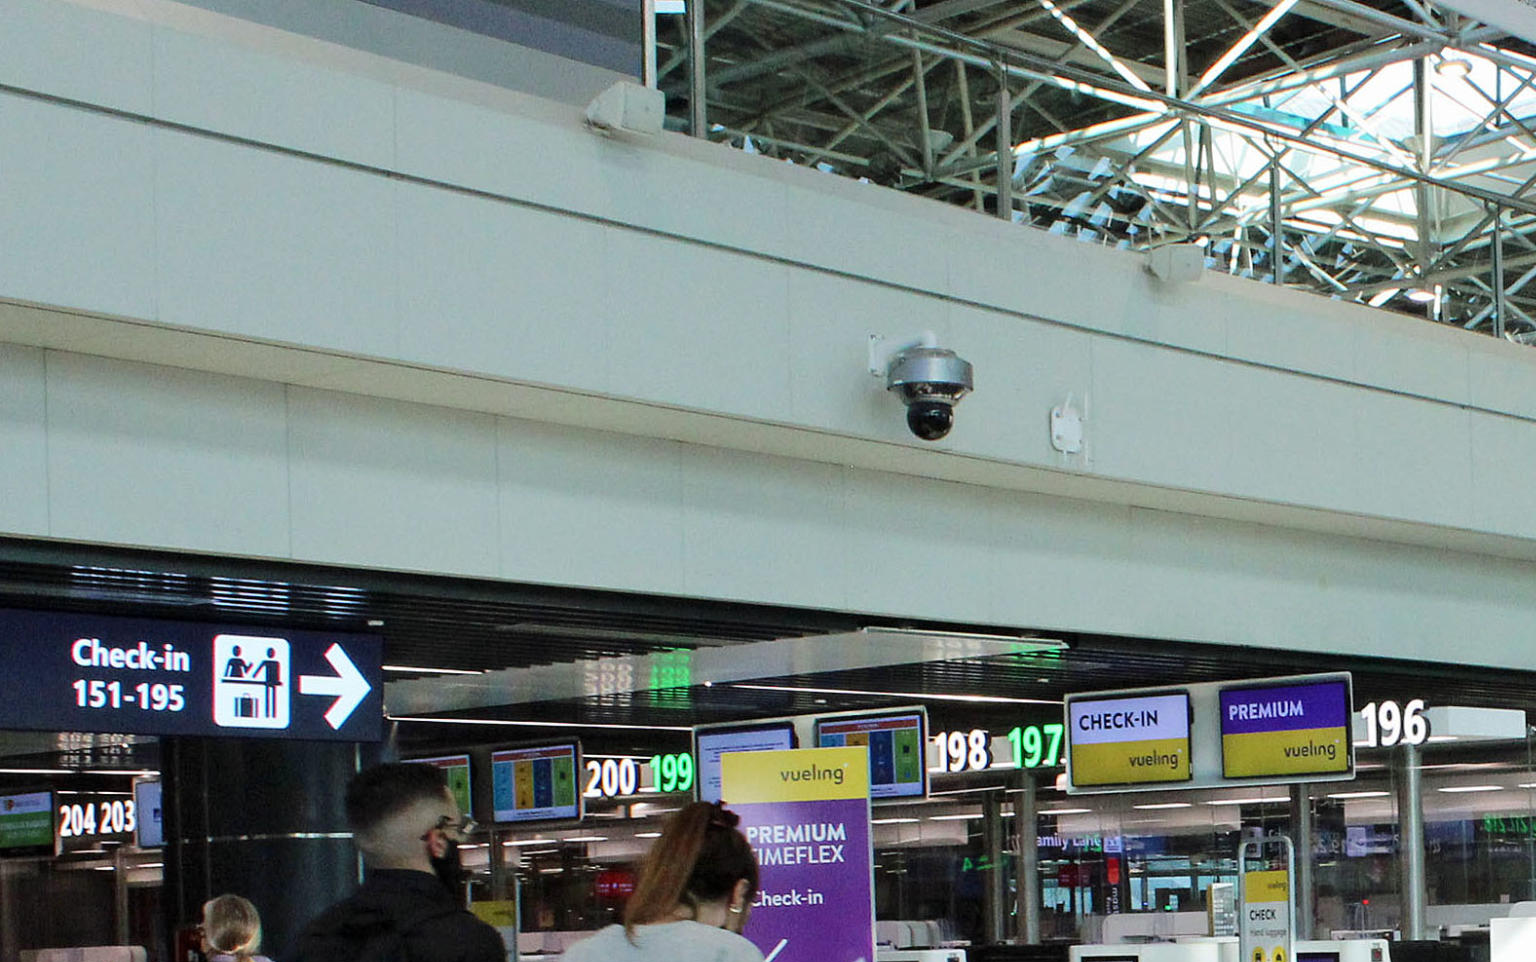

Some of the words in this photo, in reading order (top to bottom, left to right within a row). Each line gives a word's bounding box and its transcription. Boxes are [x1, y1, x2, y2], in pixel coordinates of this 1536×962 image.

[71, 638, 191, 672] Check-in
[72, 679, 185, 712] 151-195
[1229, 700, 1304, 720] PREMIUM
[1079, 710, 1158, 731] CHECK-IN
[1361, 699, 1429, 747] 196
[934, 729, 990, 772] 198
[1007, 723, 1064, 768] 197
[1129, 750, 1179, 769] vueling
[1284, 740, 1336, 760] vueling
[585, 758, 636, 797] 200
[650, 753, 694, 793] 199
[780, 764, 844, 785] vueling
[59, 803, 96, 837] 204
[100, 800, 135, 834] 203
[746, 823, 847, 844] PREMIUM
[1036, 832, 1068, 851] amily
[1249, 909, 1277, 921] CHECK
